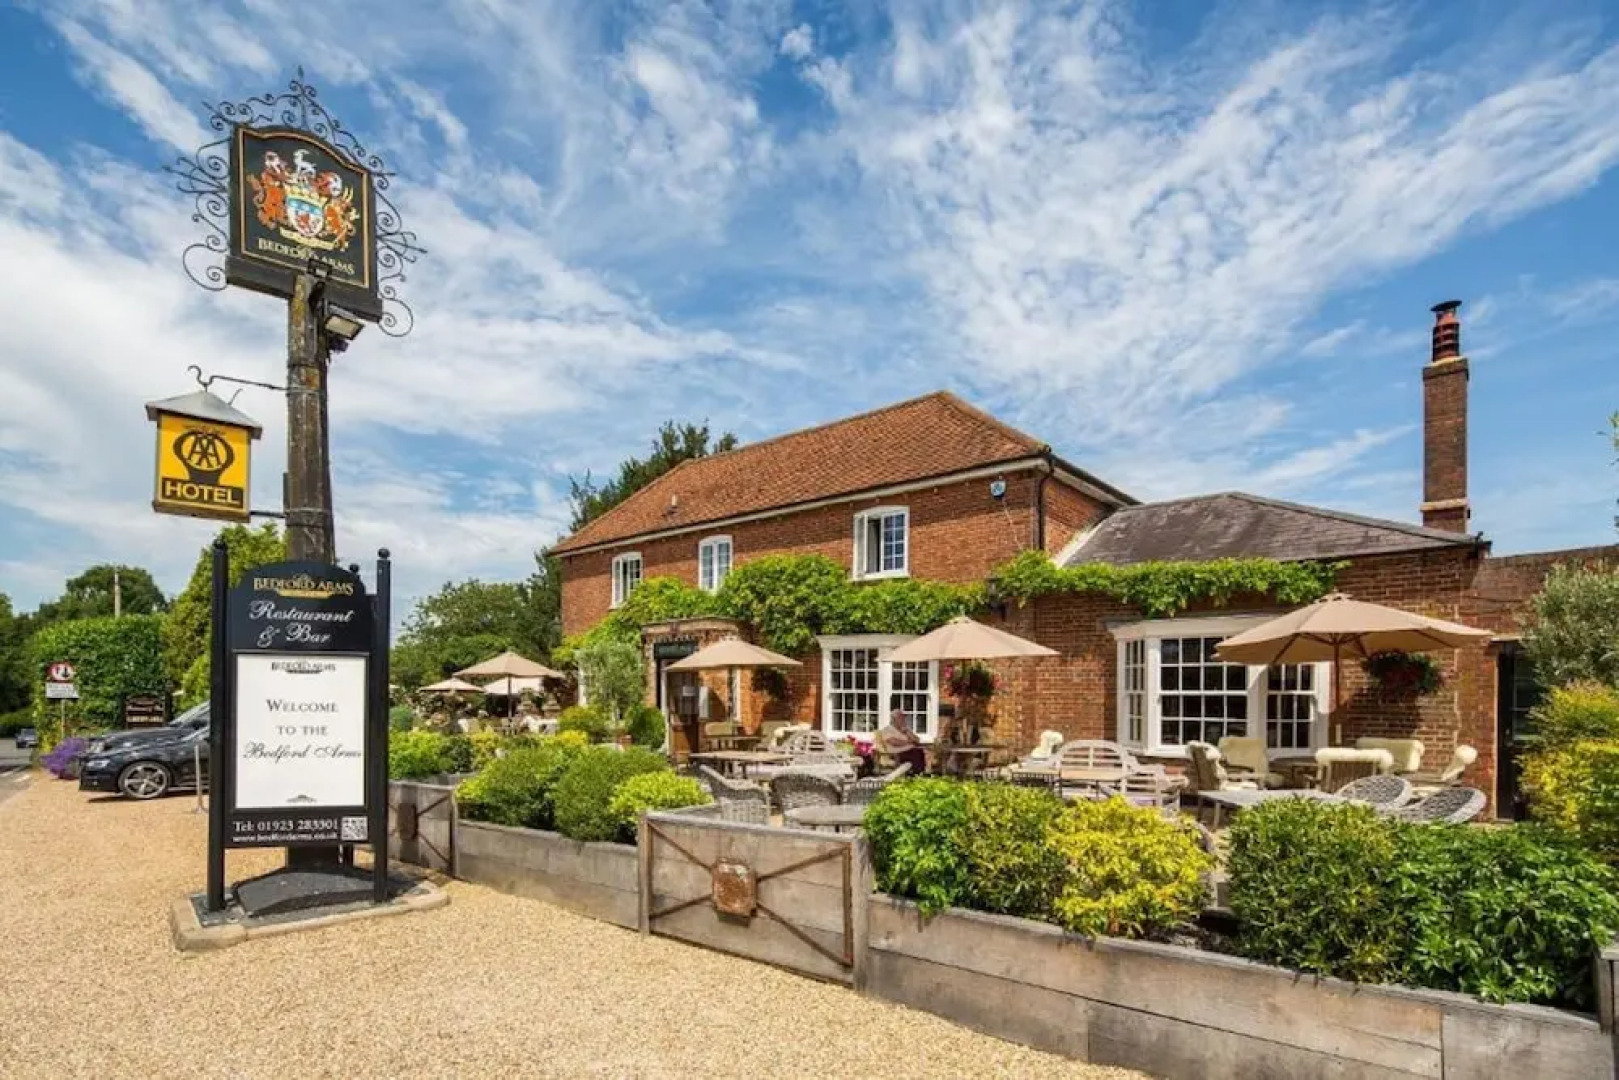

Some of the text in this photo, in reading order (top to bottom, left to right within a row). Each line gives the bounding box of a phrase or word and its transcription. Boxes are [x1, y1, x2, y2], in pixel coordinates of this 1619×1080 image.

[165, 480, 240, 505] HOTEL
[253, 577, 315, 591] BEDFORD
[317, 580, 354, 596] ARMS
[249, 600, 355, 623] Restaurant
[257, 621, 331, 648] & Bar
[243, 741, 362, 763] Bedford Arms
[257, 820, 294, 832] 01923
